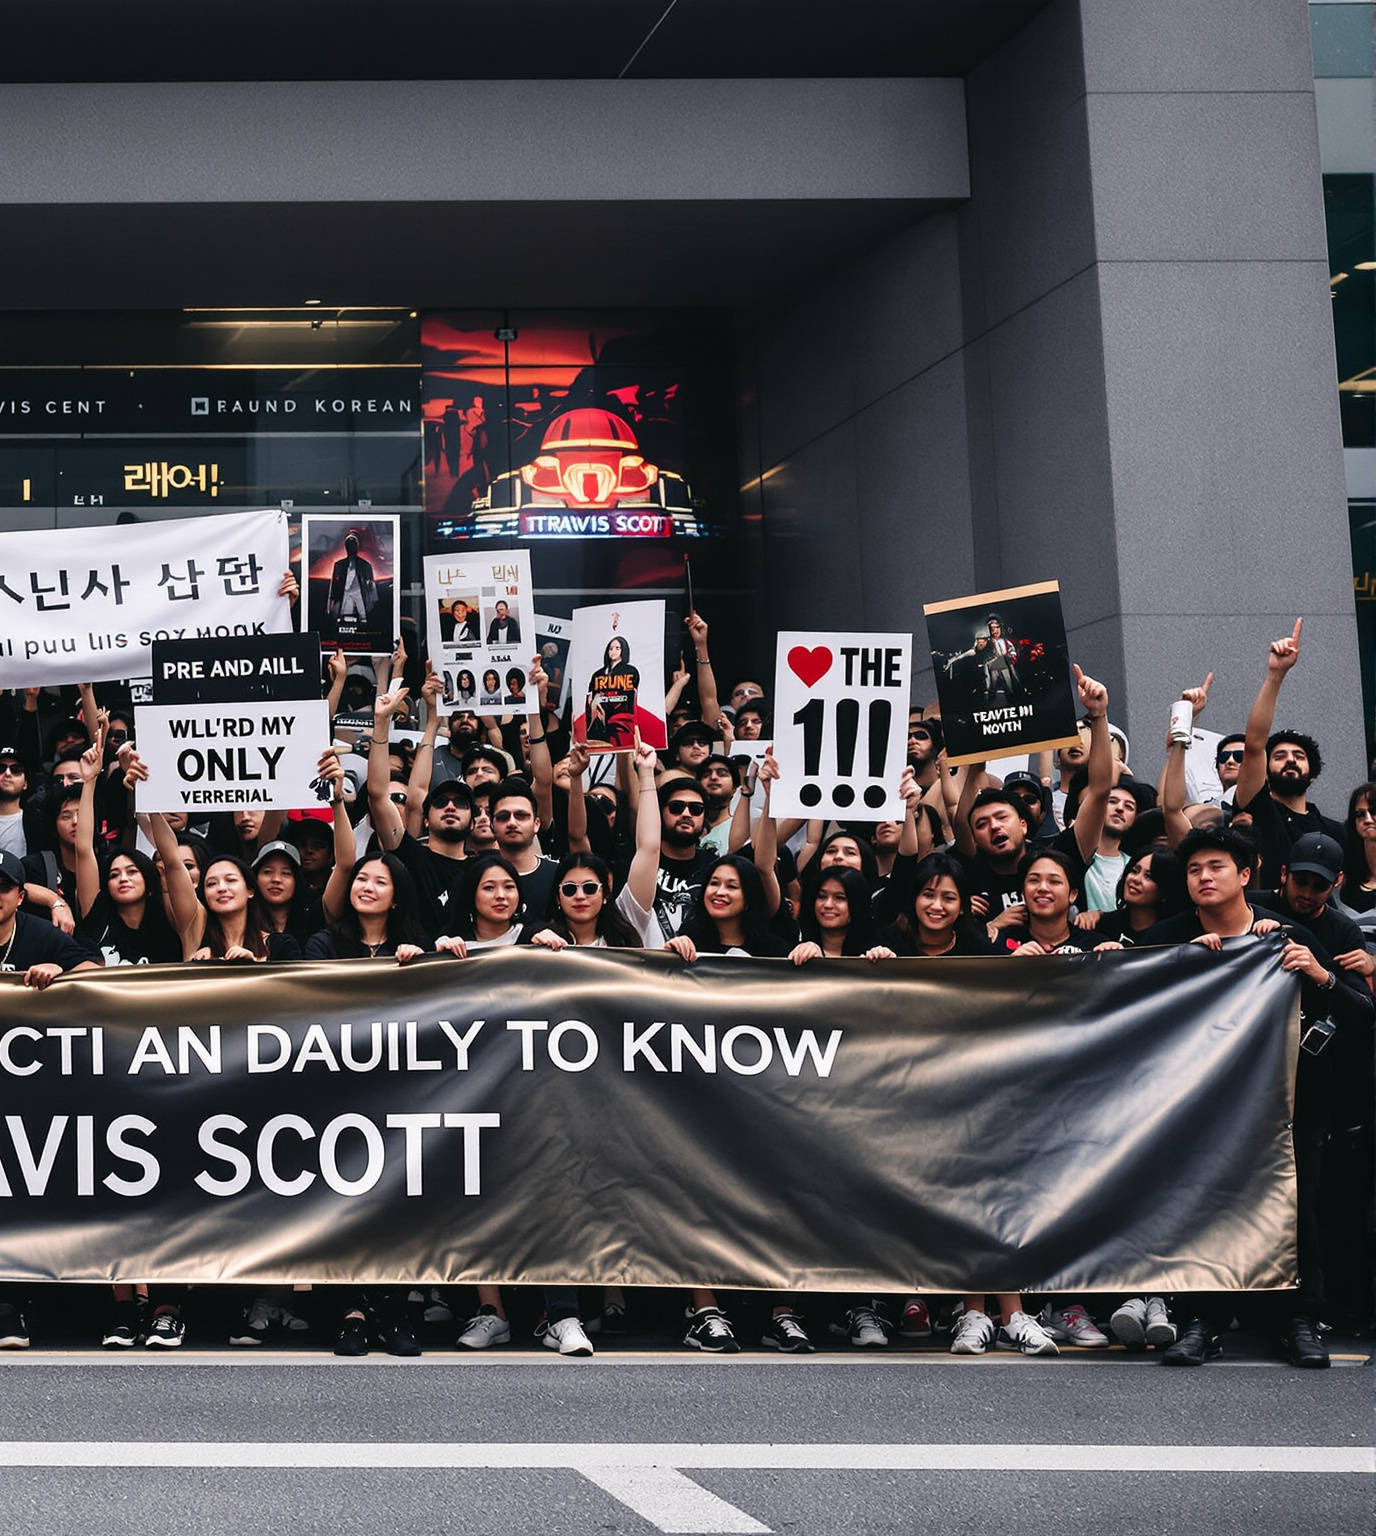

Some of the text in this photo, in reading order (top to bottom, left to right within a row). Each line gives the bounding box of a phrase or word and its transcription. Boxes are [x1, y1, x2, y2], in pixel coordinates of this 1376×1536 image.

[45, 401, 106, 414] CENT
[315, 400, 412, 413] KOREAN
[163, 662, 205, 680] PRE
[210, 659, 254, 678] AND
[840, 647, 902, 687] THE
[261, 716, 296, 736] MY
[177, 746, 286, 783] ONLY
[127, 1026, 222, 1075] AN
[247, 1021, 485, 1074] DAUILY
[506, 1020, 600, 1072] TO
[623, 1022, 843, 1077] KNOW
[194, 1113, 500, 1197] SCOTT
